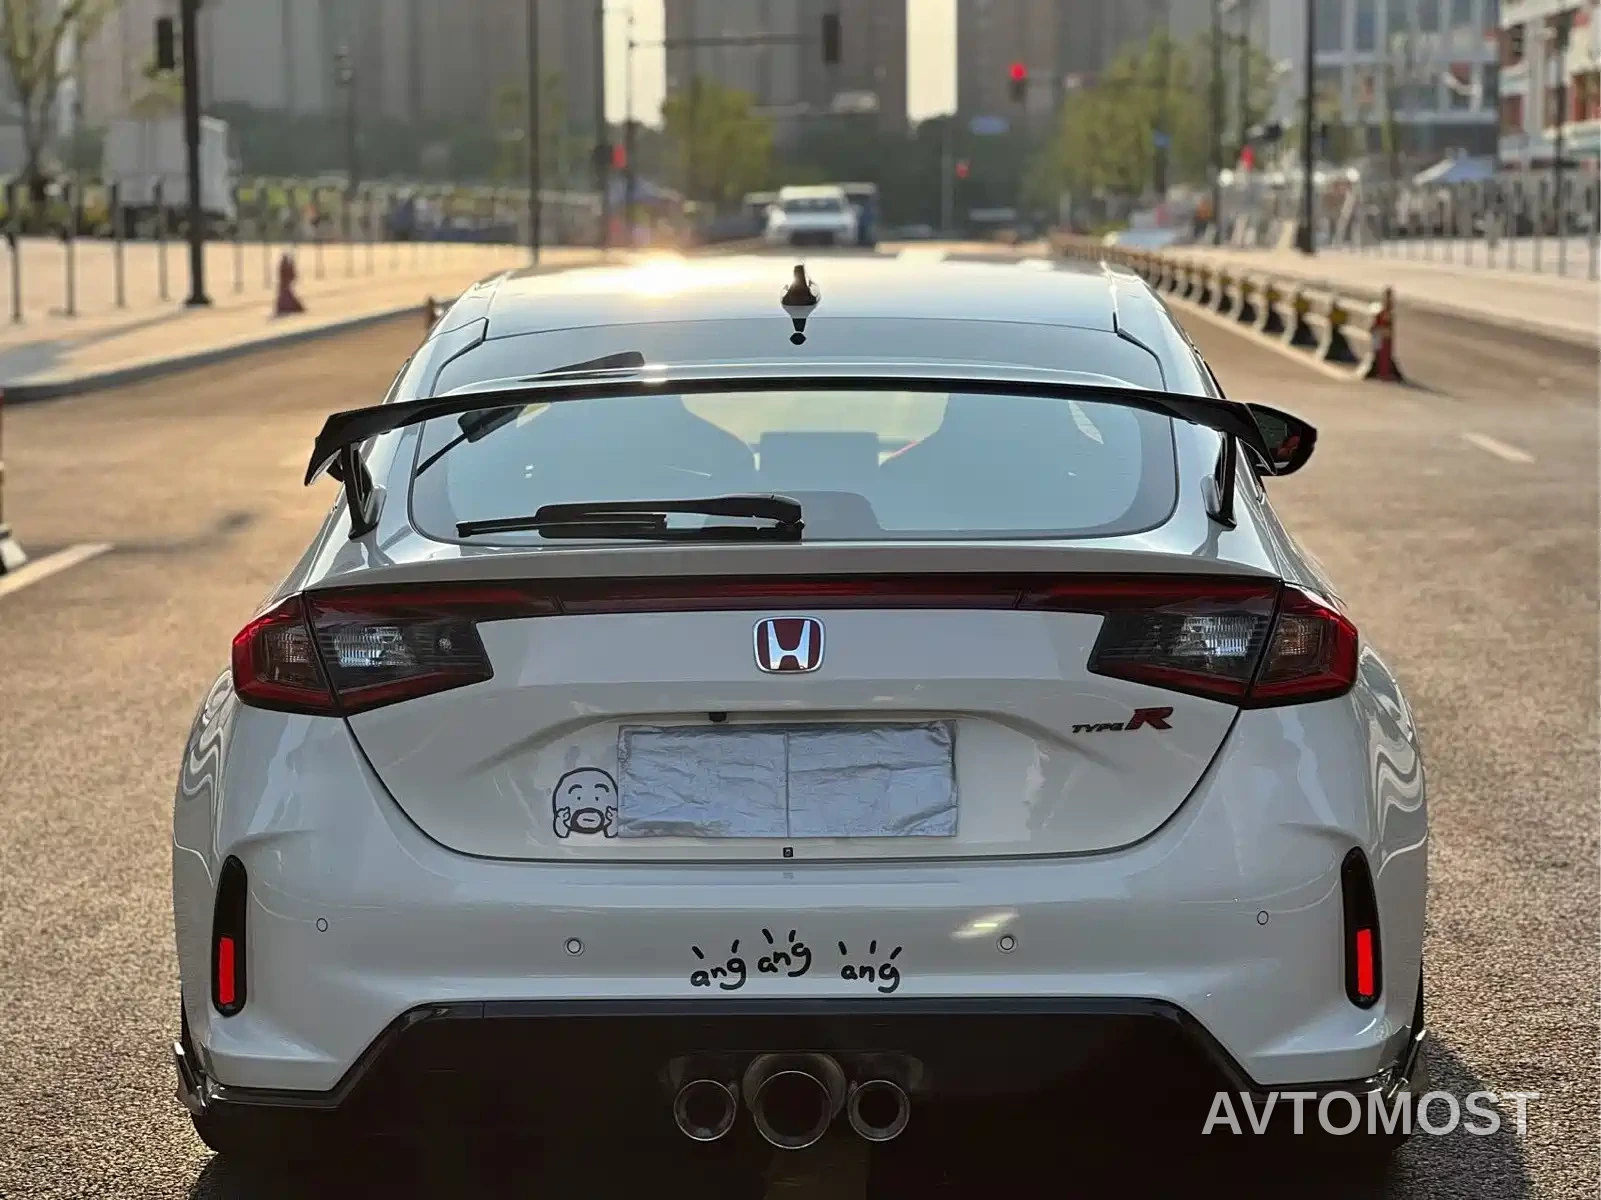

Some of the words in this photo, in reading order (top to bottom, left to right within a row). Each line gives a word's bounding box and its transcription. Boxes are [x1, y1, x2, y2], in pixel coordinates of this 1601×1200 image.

[1071, 721, 1125, 734] TYPE
[1124, 706, 1174, 731] R
[690, 957, 747, 991] ang
[757, 941, 812, 978] ang
[840, 962, 901, 994] ang
